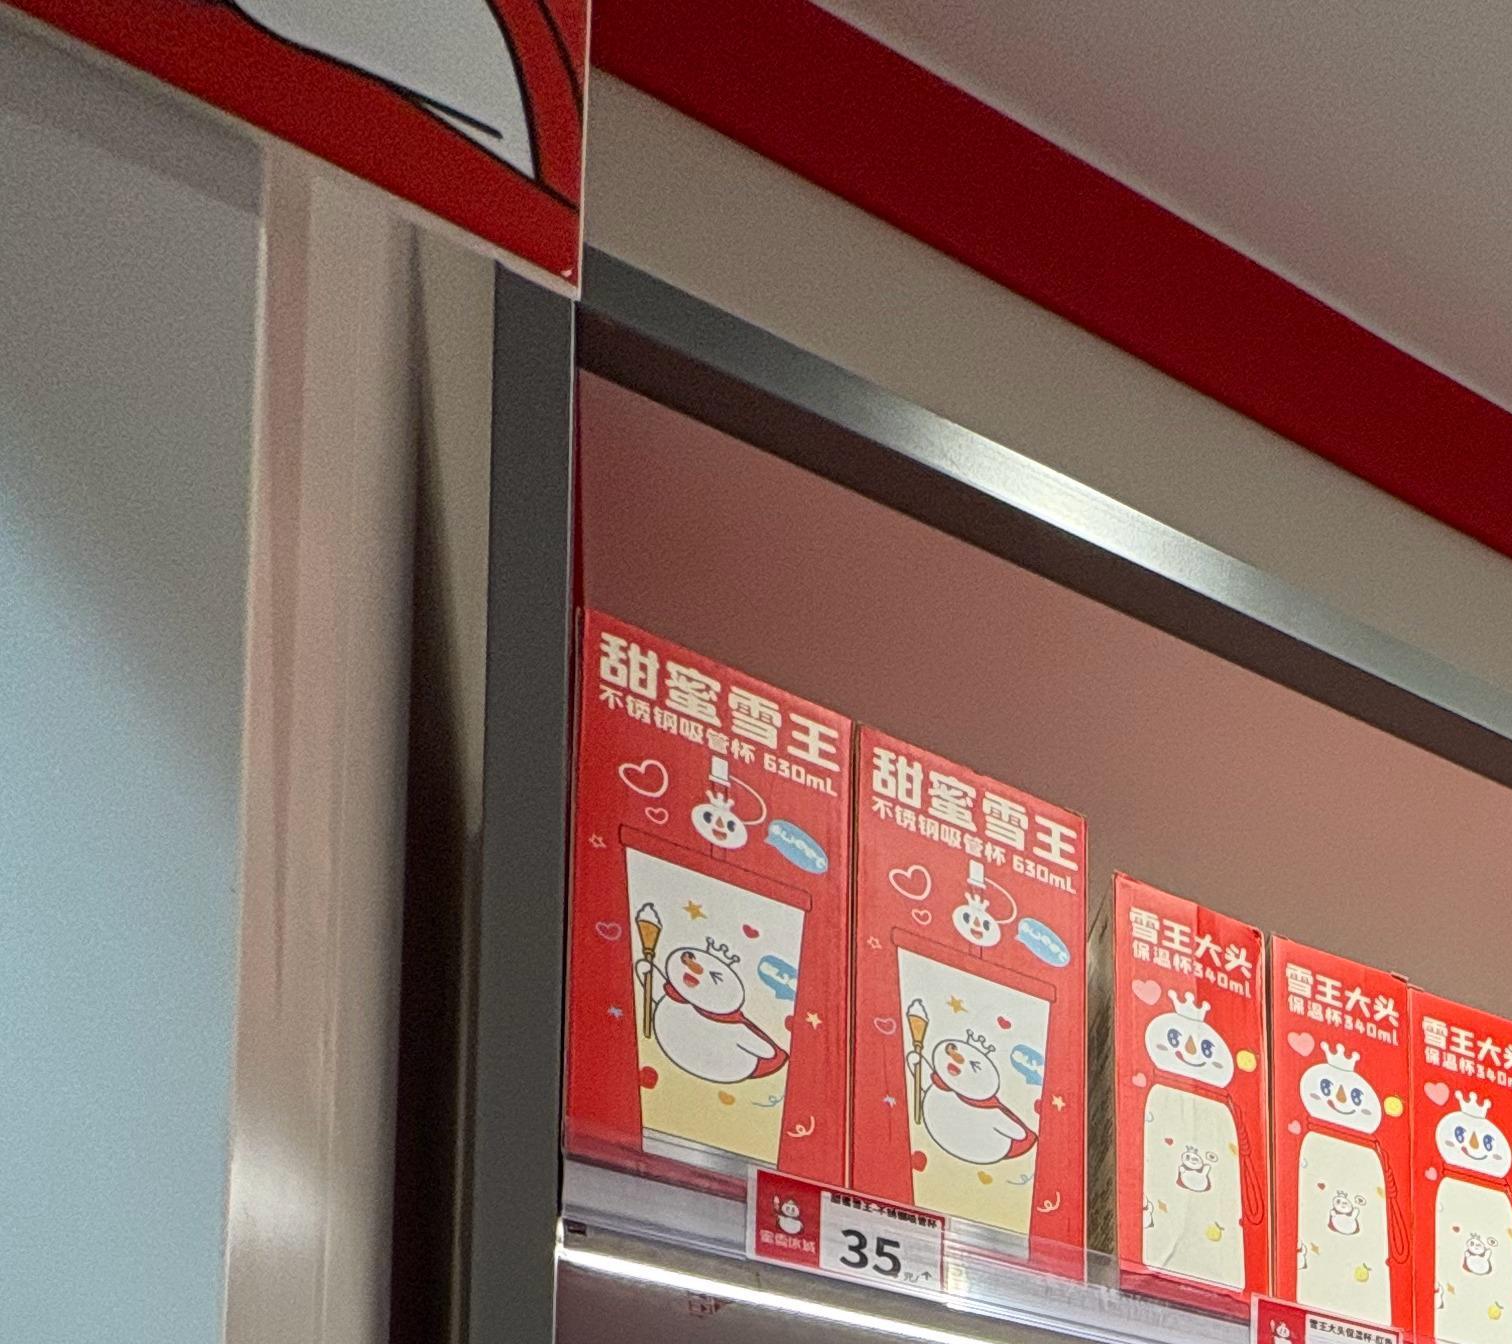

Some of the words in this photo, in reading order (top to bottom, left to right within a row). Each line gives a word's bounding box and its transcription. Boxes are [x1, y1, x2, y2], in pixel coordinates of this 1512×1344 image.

[595, 630, 842, 773] 甜蜜雪王
[598, 686, 757, 766] 不锈钢吸管杯
[763, 754, 838, 798] 630mL
[871, 797, 1007, 866] 不锈钢吸管杯
[1012, 854, 1078, 895] 630mL
[872, 745, 1079, 872] 甜蜜雪王
[1128, 906, 1253, 978] 雪王大头
[1285, 963, 1400, 1027] 雪王大头
[839, 1228, 902, 1279] 35
